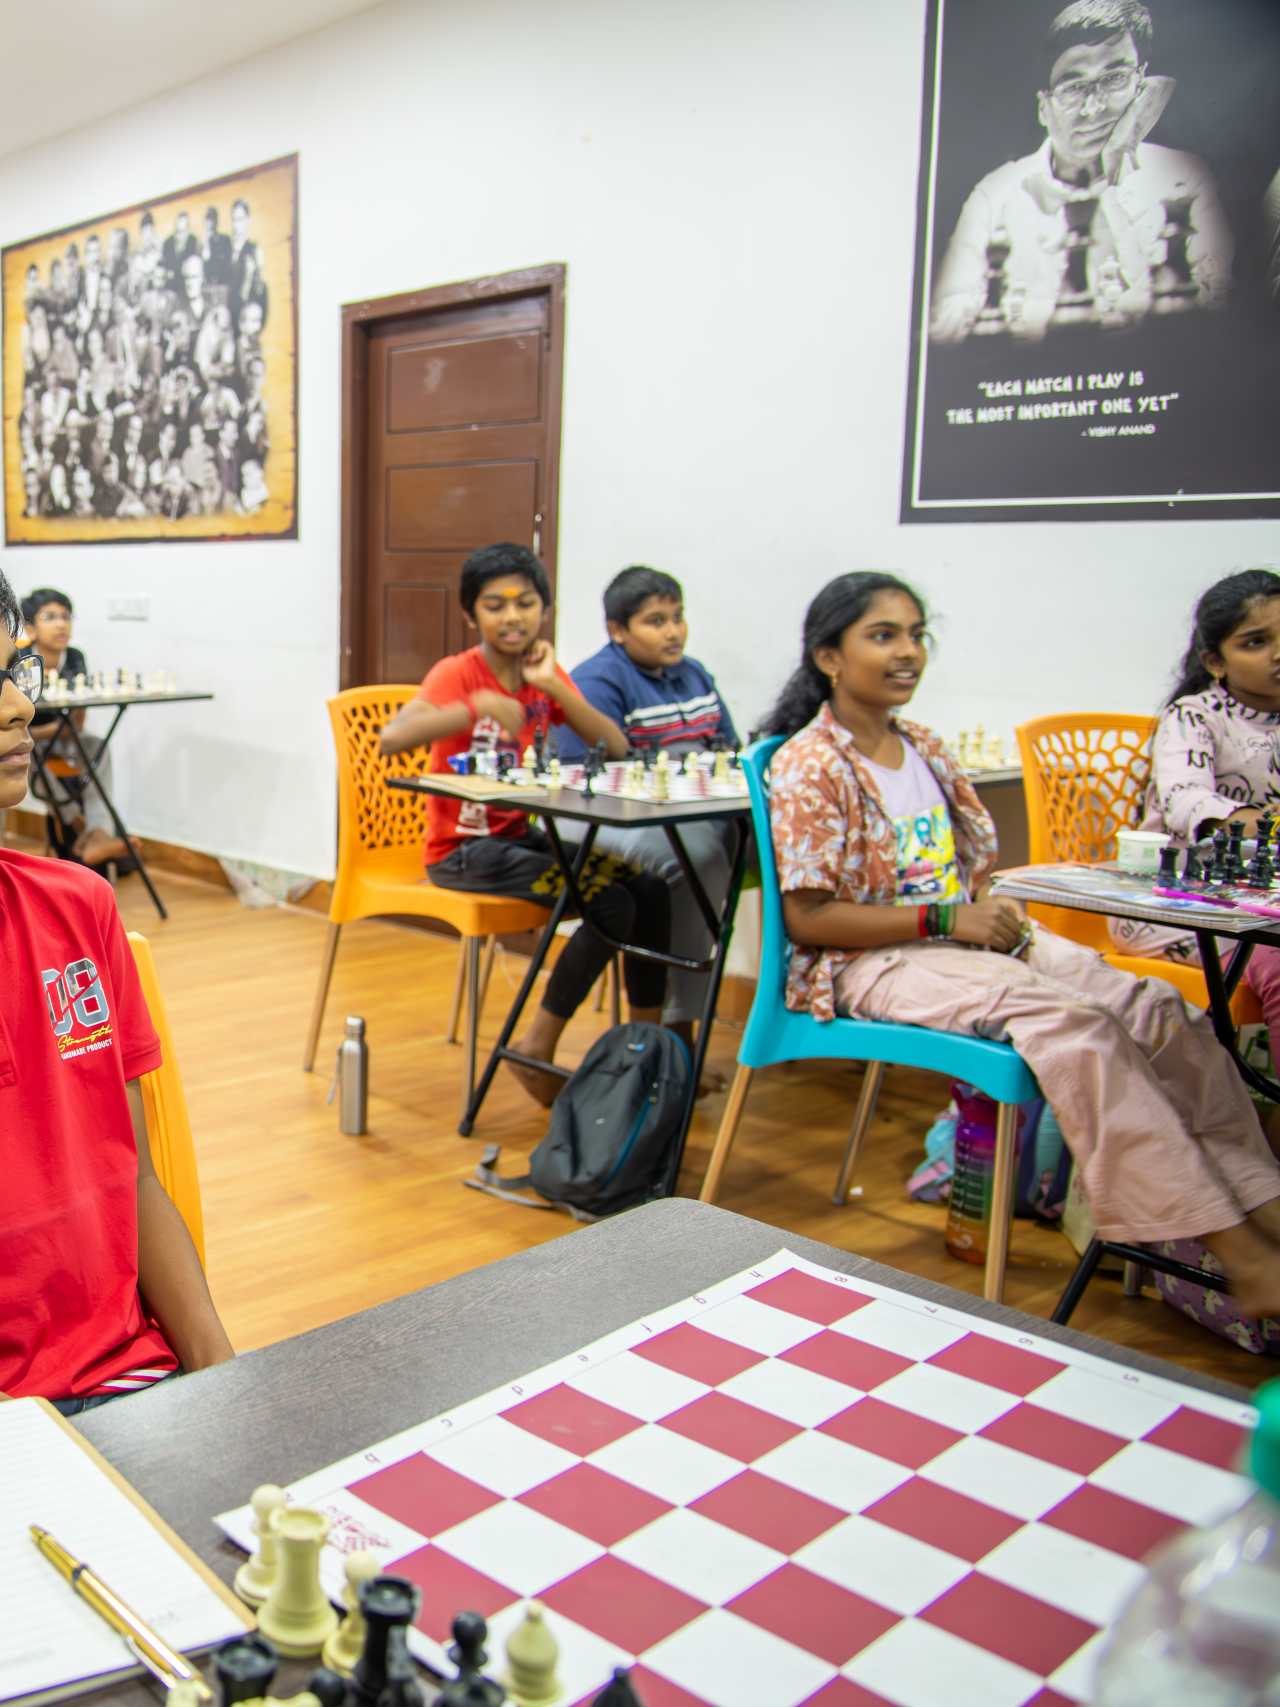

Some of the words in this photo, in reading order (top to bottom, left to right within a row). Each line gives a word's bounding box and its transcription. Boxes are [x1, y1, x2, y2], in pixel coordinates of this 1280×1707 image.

[1025, 374, 1074, 396] MATCH
[1076, 374, 1084, 391] I
[1087, 371, 1126, 390] PLAY
[1129, 370, 1145, 387] IS
[946, 407, 975, 426] THE
[976, 404, 1015, 424] MOST
[1017, 399, 1099, 421] IMPORTANT
[1101, 396, 1134, 415] ONE
[1088, 425, 1118, 438] VISHY
[1117, 423, 1157, 437] ANAND
[41, 957, 110, 1036] 08
[86, 1038, 113, 1053] PRODUCT
